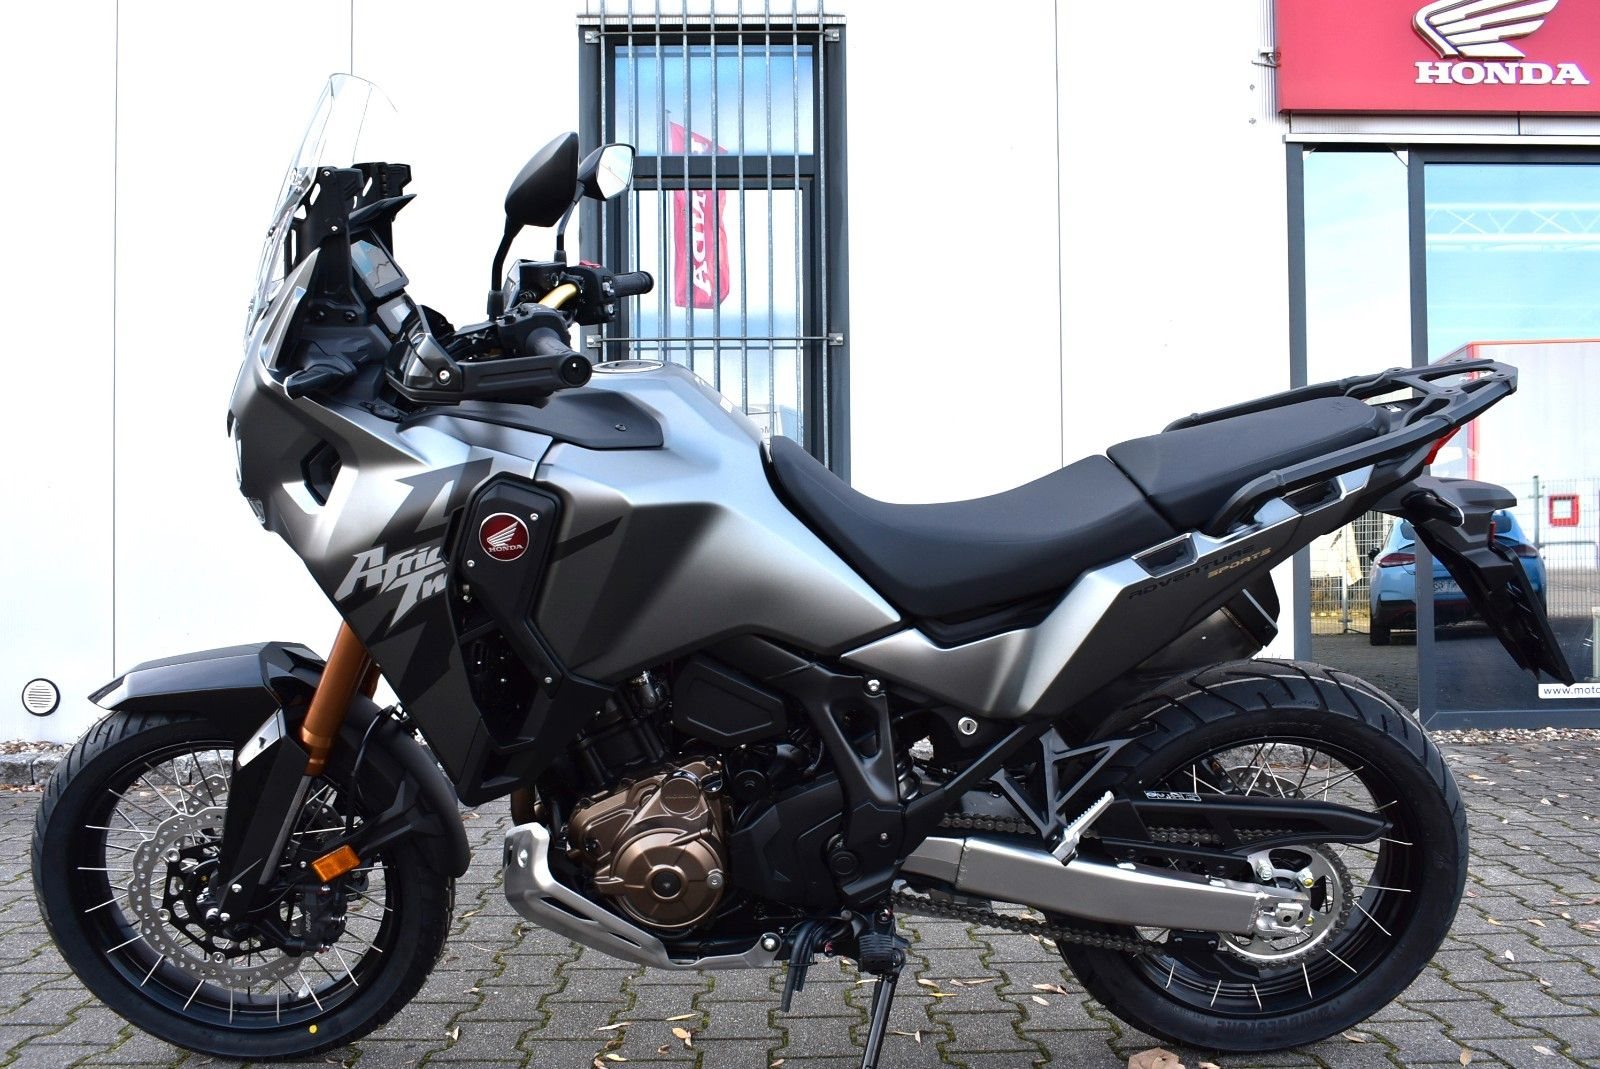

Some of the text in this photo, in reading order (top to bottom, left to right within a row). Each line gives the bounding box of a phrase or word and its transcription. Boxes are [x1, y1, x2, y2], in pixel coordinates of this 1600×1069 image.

[1415, 61, 1590, 85] HONDA
[488, 545, 524, 553] HONDA
[1207, 547, 1272, 579] SPORTS
[1128, 545, 1255, 600] ADVENTURE
